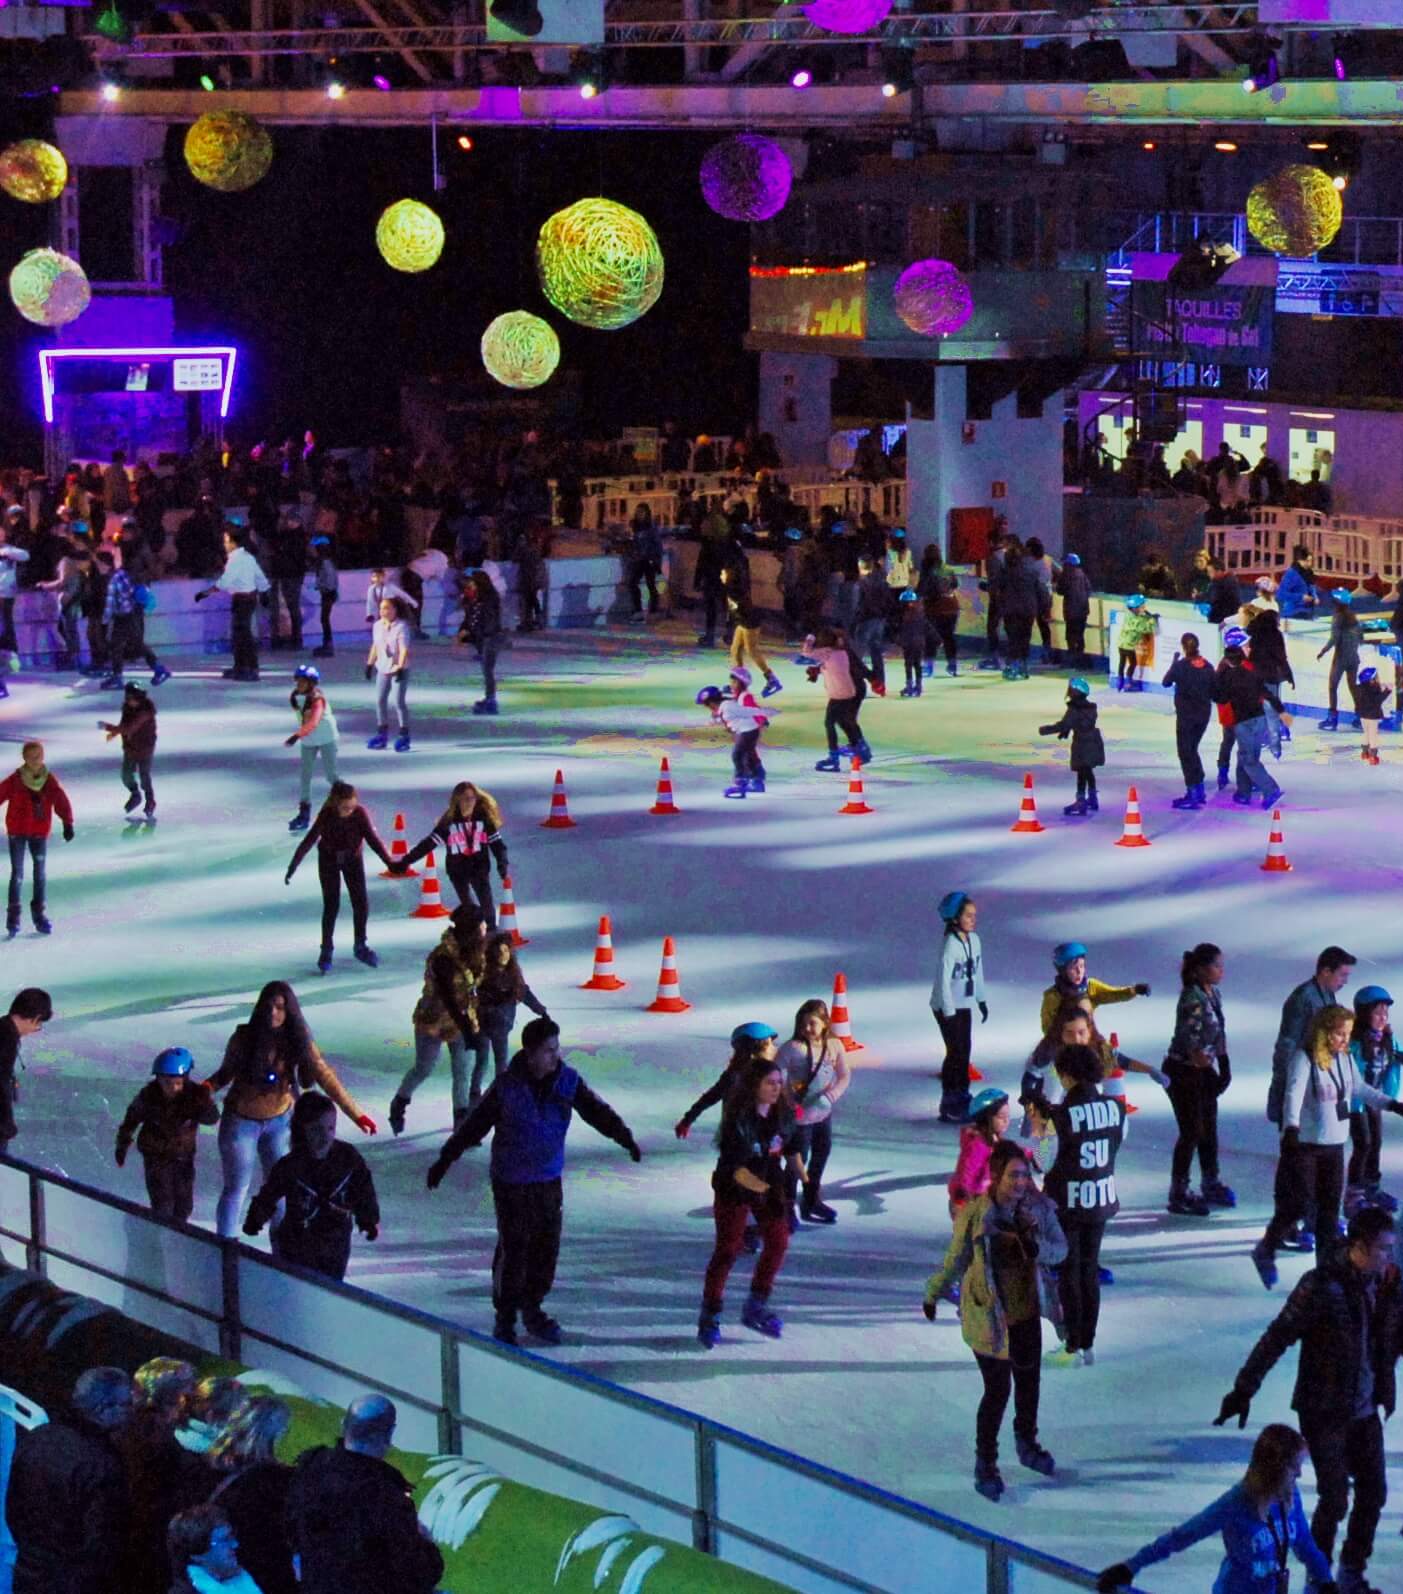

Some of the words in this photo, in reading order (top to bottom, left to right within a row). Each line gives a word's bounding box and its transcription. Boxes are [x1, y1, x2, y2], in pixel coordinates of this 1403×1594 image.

[1068, 1099, 1121, 1133] PIDA
[1080, 1138, 1109, 1169] SU
[1067, 1174, 1117, 1209] FOTO
